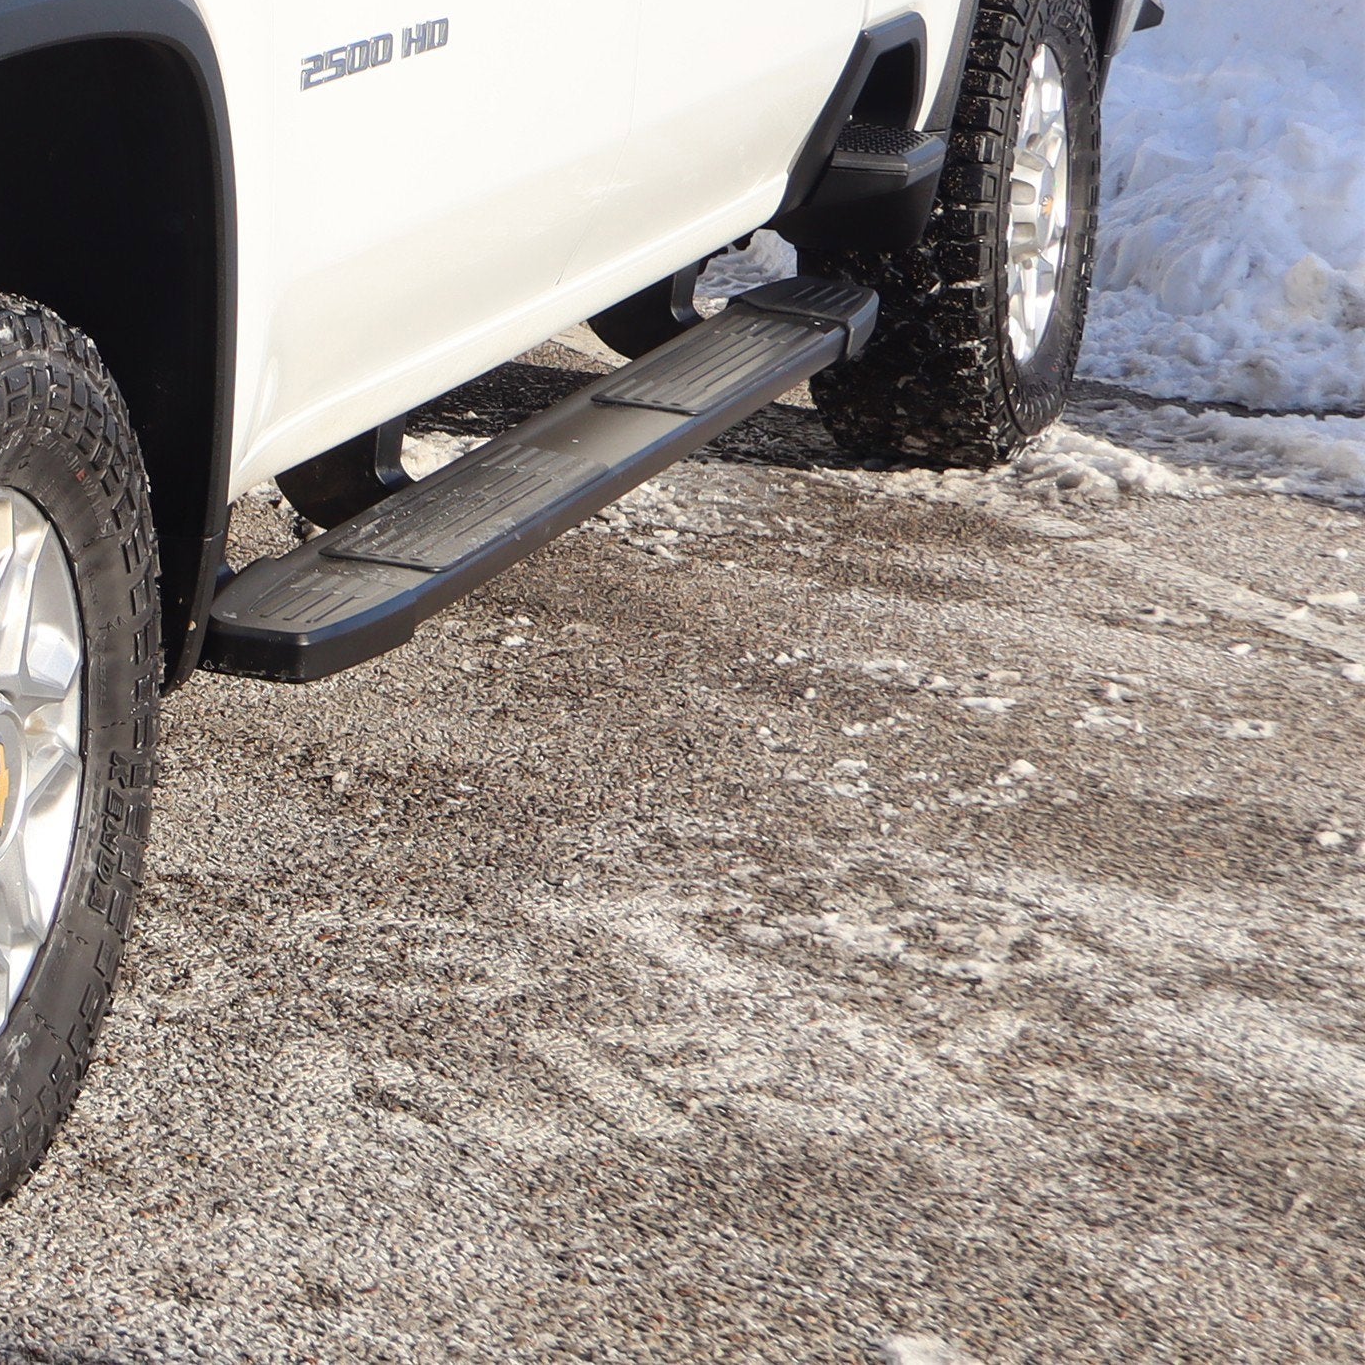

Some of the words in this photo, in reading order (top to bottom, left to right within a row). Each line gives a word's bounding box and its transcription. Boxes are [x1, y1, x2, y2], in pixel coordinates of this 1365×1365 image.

[300, 32, 393, 91] 2500
[401, 17, 449, 59] HD
[88, 749, 130, 916] KENDA
